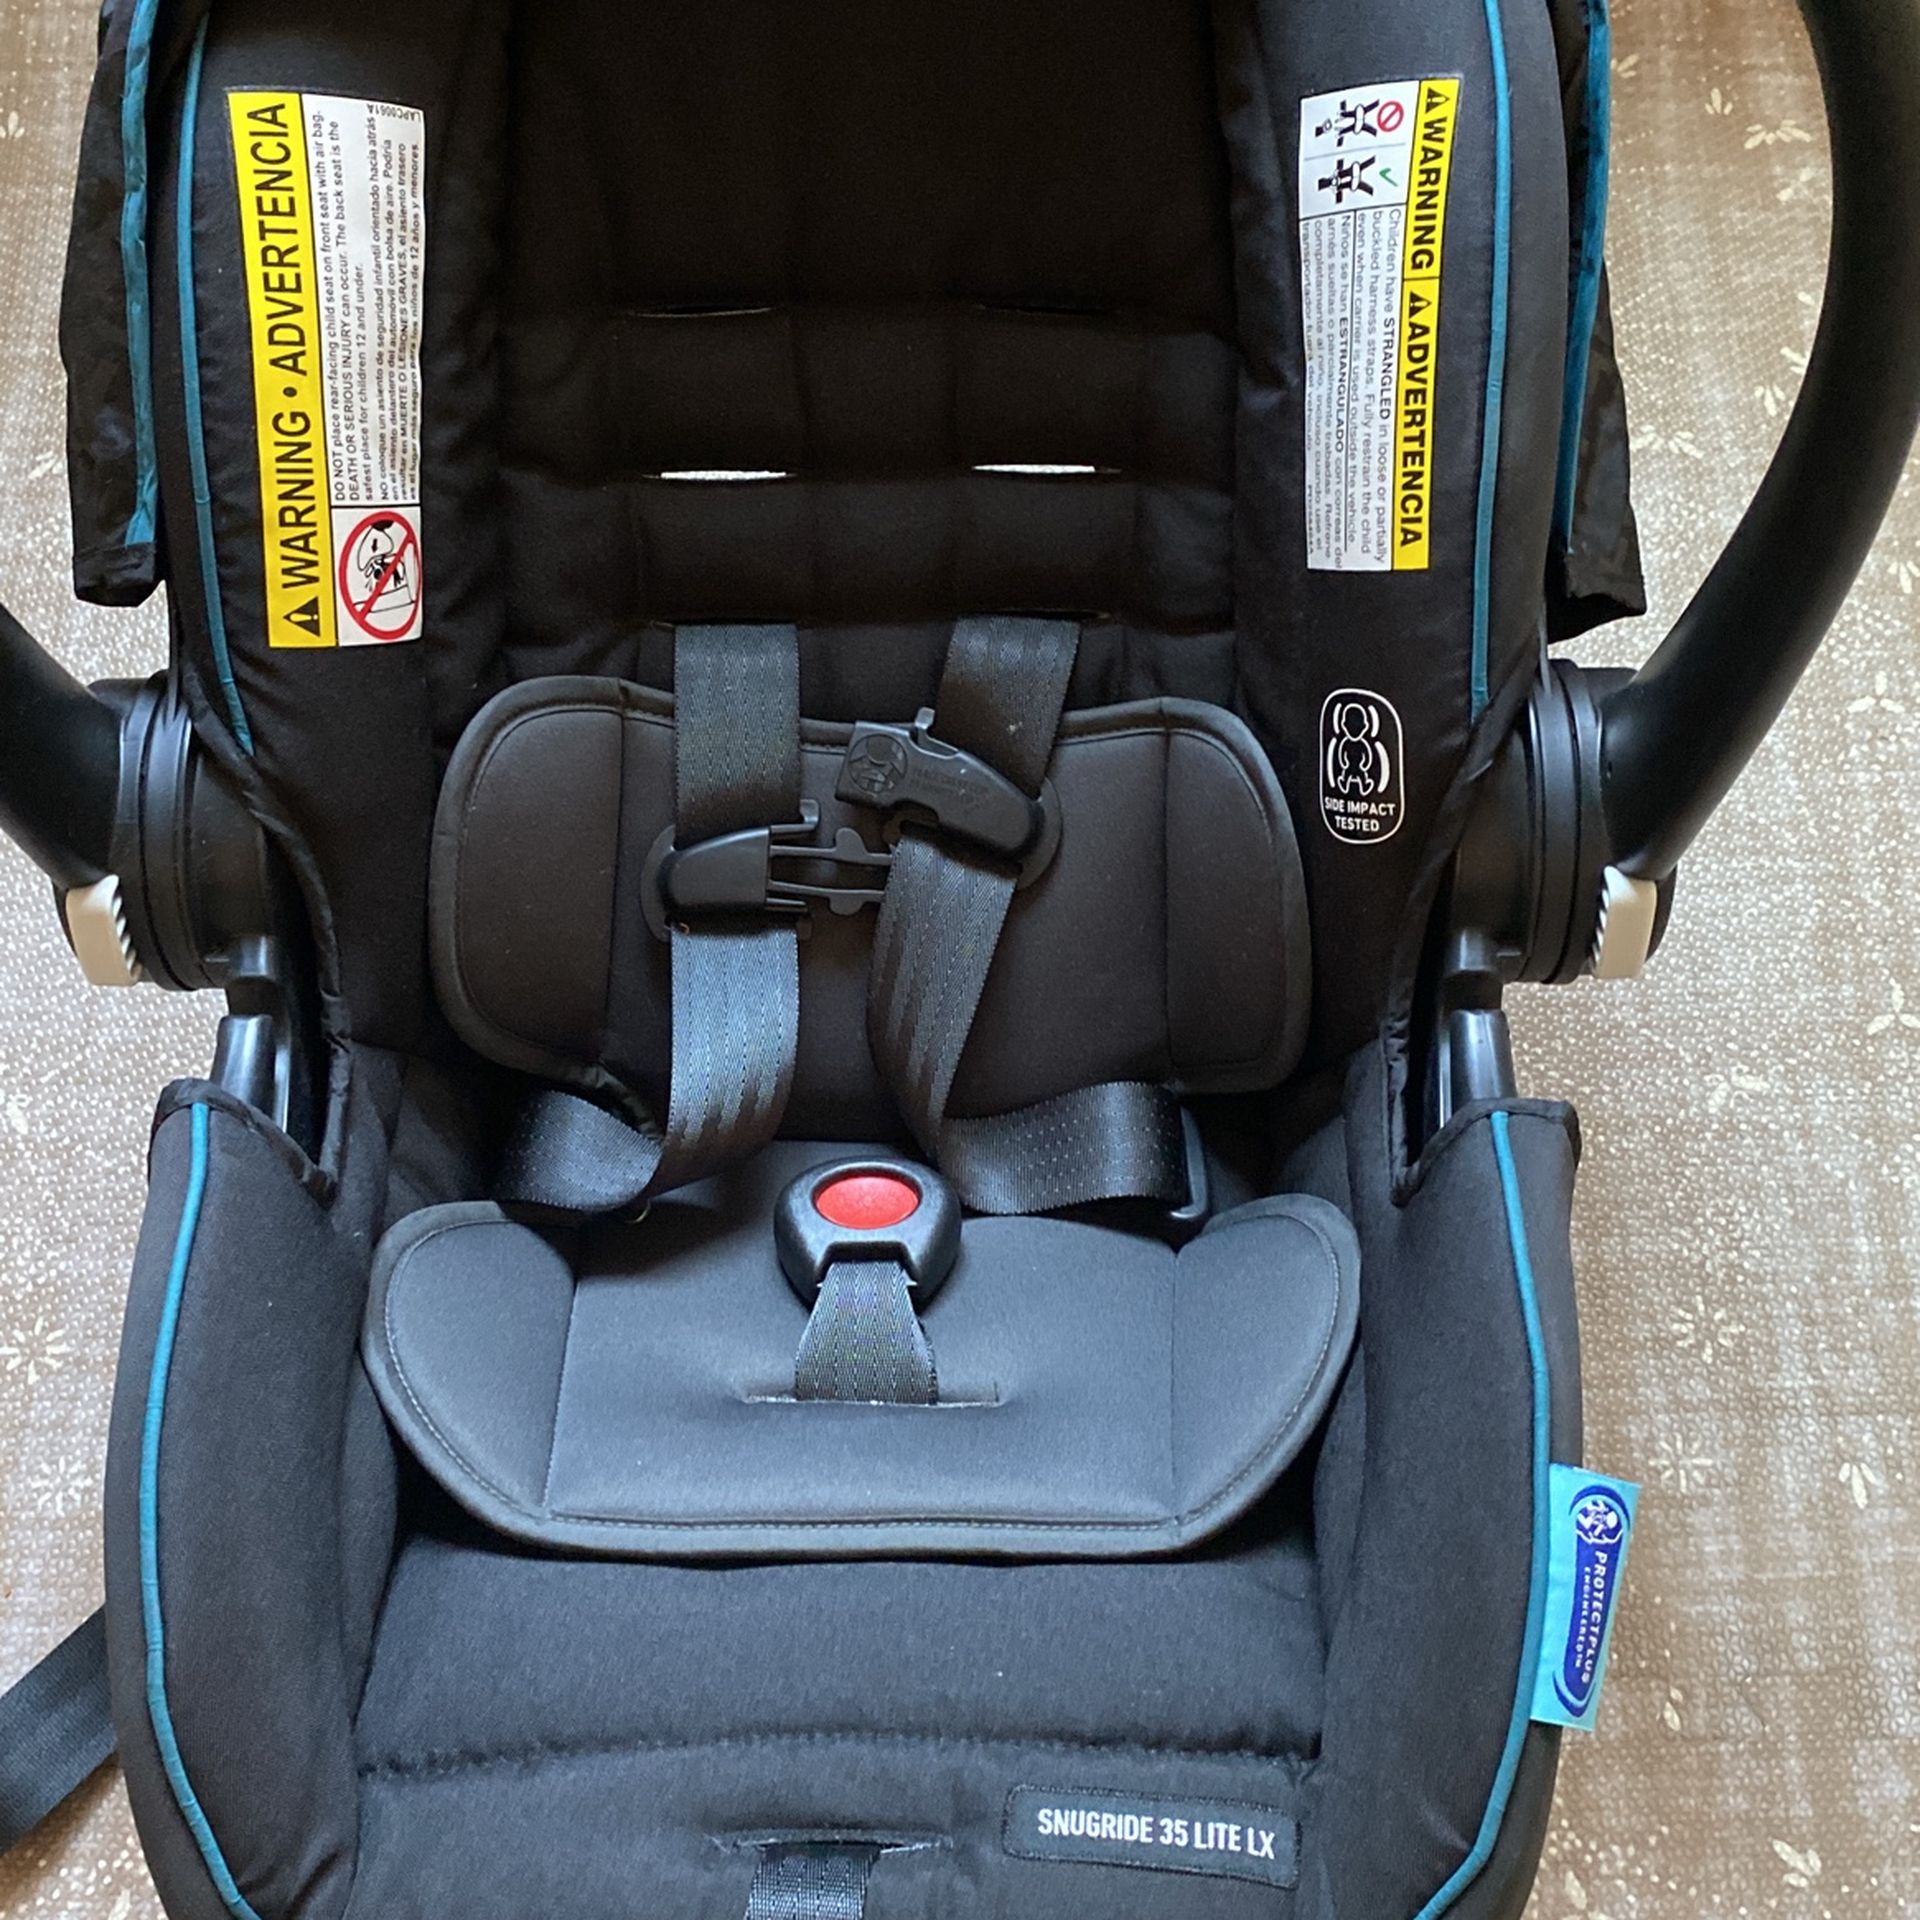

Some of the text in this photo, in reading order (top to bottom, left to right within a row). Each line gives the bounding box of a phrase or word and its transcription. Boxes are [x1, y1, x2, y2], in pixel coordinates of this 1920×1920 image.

[329, 121, 339, 141] the
[330, 145, 340, 156] is
[332, 159, 343, 186] seat
[367, 150, 378, 181] hacia
[334, 190, 345, 220] back
[370, 185, 380, 242] orientado
[1411, 118, 1448, 270] WARNING
[336, 224, 346, 246] The
[1371, 211, 1383, 269] buckled
[371, 245, 382, 285] infantil
[1356, 253, 1365, 293] when
[312, 111, 345, 501] DO NOT place rear-facing child seat on front seat with air bag.
[341, 294, 350, 317] can
[375, 288, 386, 347] seguridad
[1368, 275, 1380, 334] harness
[247, 104, 319, 587] WARNING ADVERTENCIA
[341, 320, 352, 368] INJURY
[376, 351, 384, 365] de
[1354, 350, 1361, 361] is
[343, 372, 355, 431] SERIOUS
[355, 264, 372, 501] safest place for children 12 and under.
[376, 368, 384, 411] asiento
[1351, 366, 1359, 402] used
[1374, 208, 1401, 562] Children have STRANGLED in loose or partially
[379, 414, 386, 429] un
[1362, 394, 1375, 429] Fully
[346, 435, 356, 454] OR
[1350, 407, 1358, 460] outside
[1400, 323, 1428, 546] ADVERTENCIA
[379, 433, 387, 479] coloque
[1362, 433, 1372, 487] restrain
[347, 458, 360, 501] DEATH
[380, 482, 389, 500] NO
[1362, 492, 1372, 514] the
[1361, 519, 1370, 553] child
[1325, 797, 1396, 816] SIDE IMPACT
[1335, 815, 1380, 831] TESTED
[1582, 1551, 1608, 1683] PROTECTPLUS
[1037, 1809, 1275, 1859] SNUGRIDE 35 LITE LX
